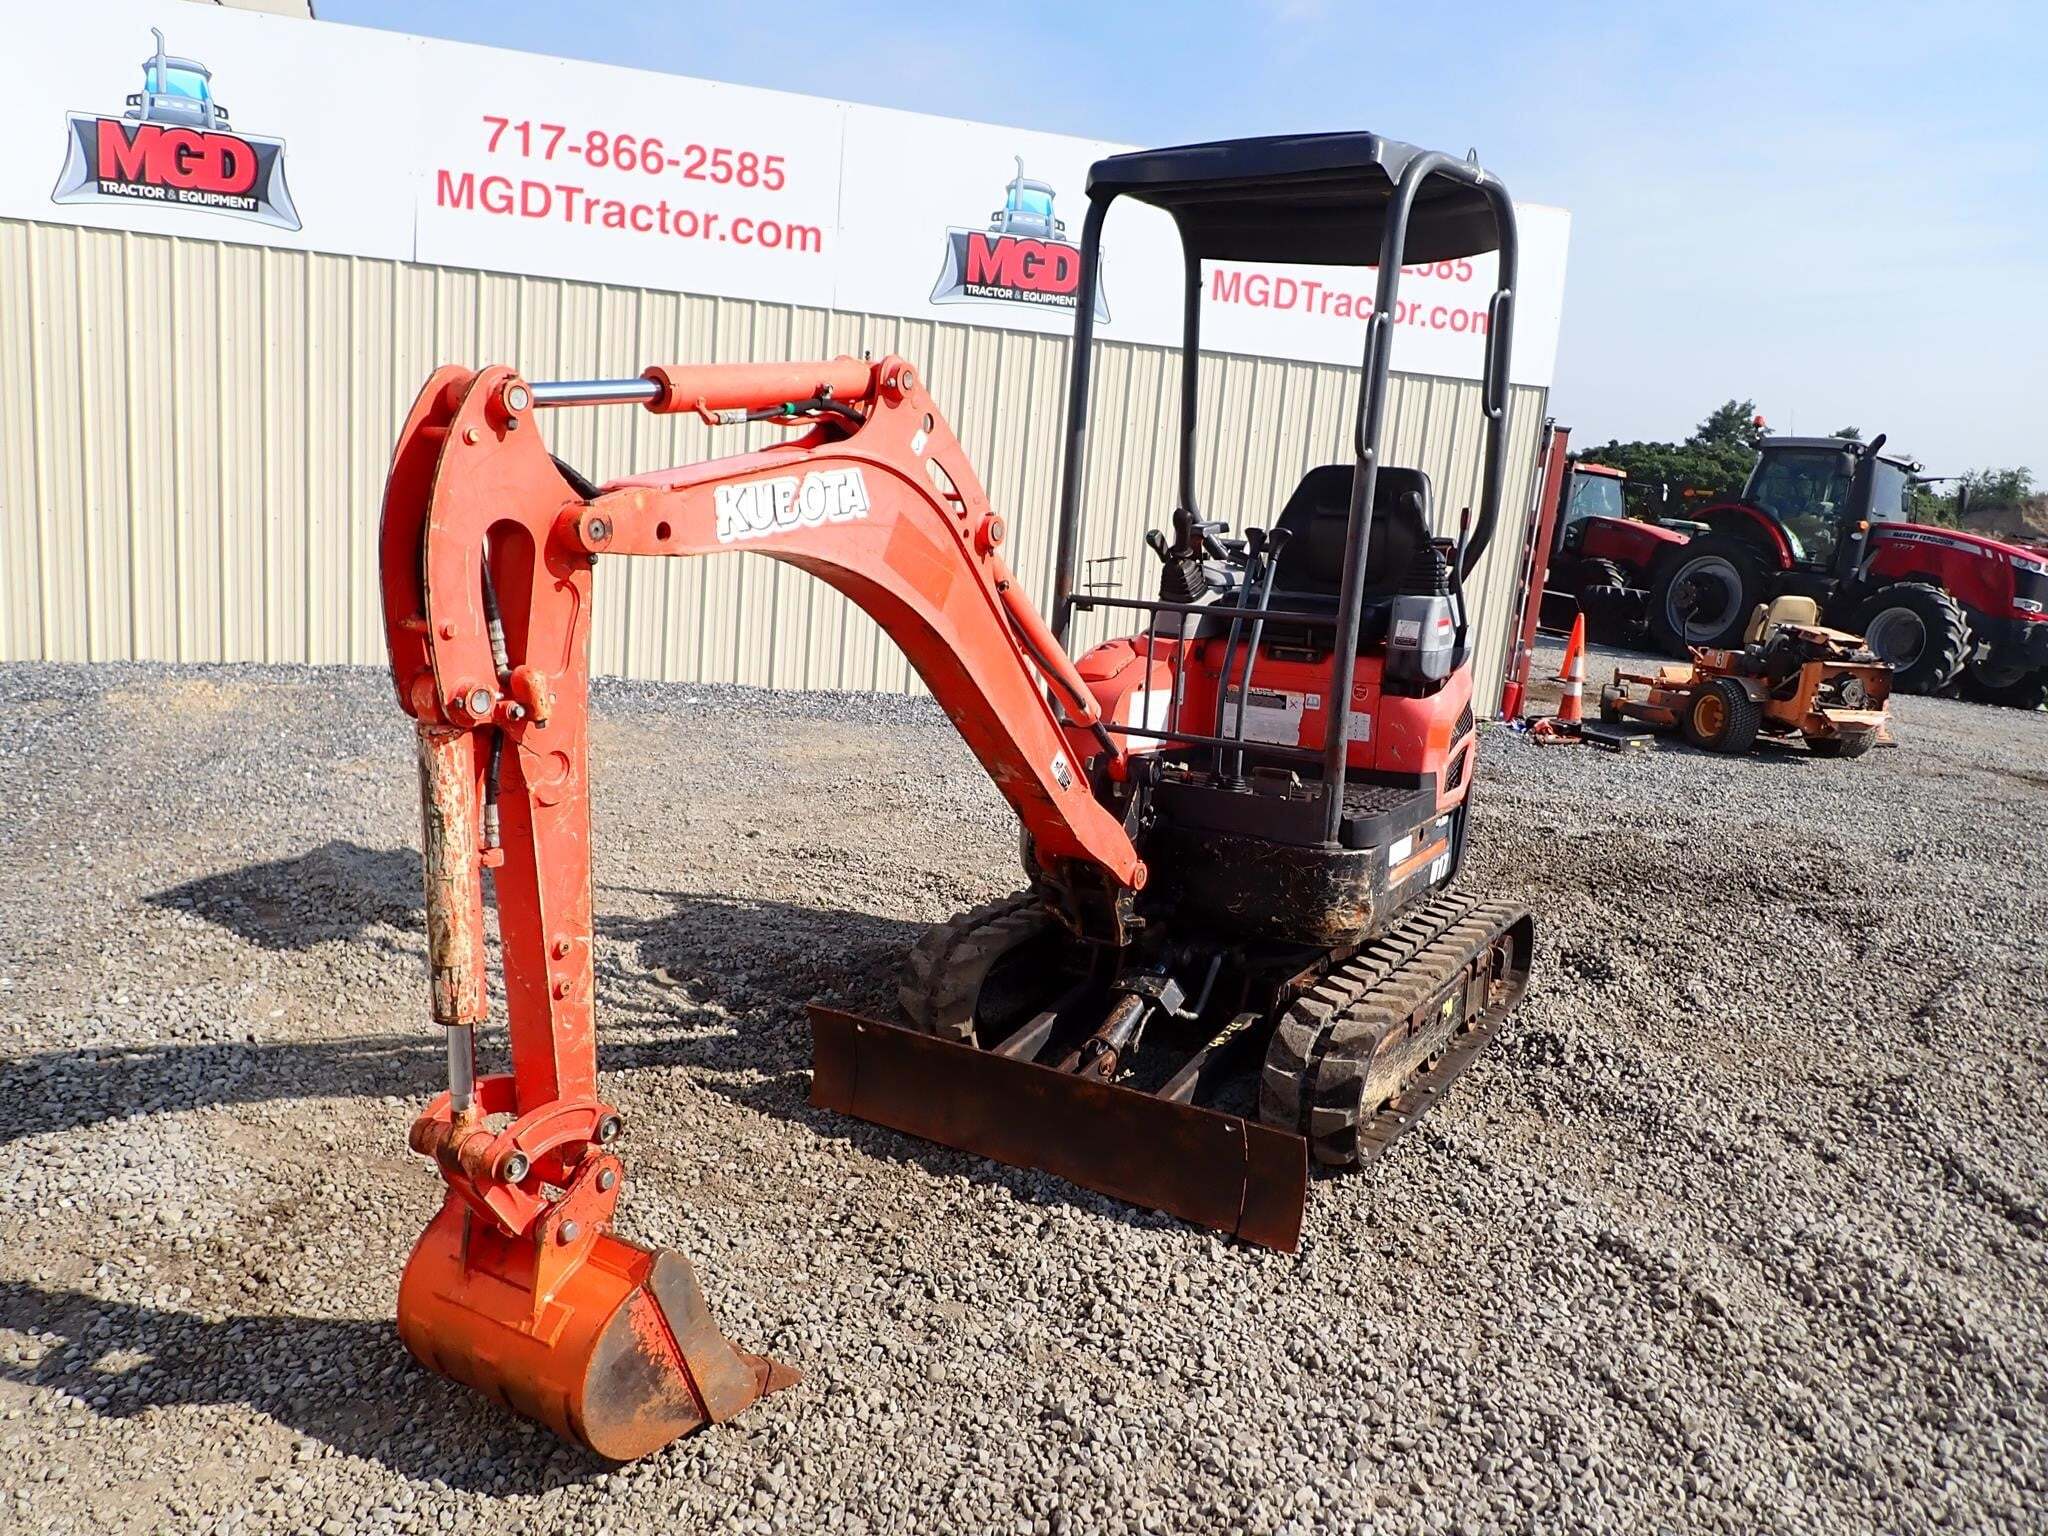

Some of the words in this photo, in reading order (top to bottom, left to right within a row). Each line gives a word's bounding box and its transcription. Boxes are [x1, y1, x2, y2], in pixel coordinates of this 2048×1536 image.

[97, 119, 257, 194] MGD
[482, 115, 785, 191] 717-866-2585
[101, 182, 165, 199] TRACTOR
[167, 190, 177, 200] &
[179, 190, 256, 211] EQUIPMENT
[436, 169, 822, 253] MGDTractor.com
[966, 284, 1012, 299] TRACTOR
[1022, 292, 1077, 307] EQUIPMENT
[967, 232, 1080, 294] MGD
[1212, 269, 1488, 335] MGDTracor.com
[714, 468, 871, 543] KUBOTA
